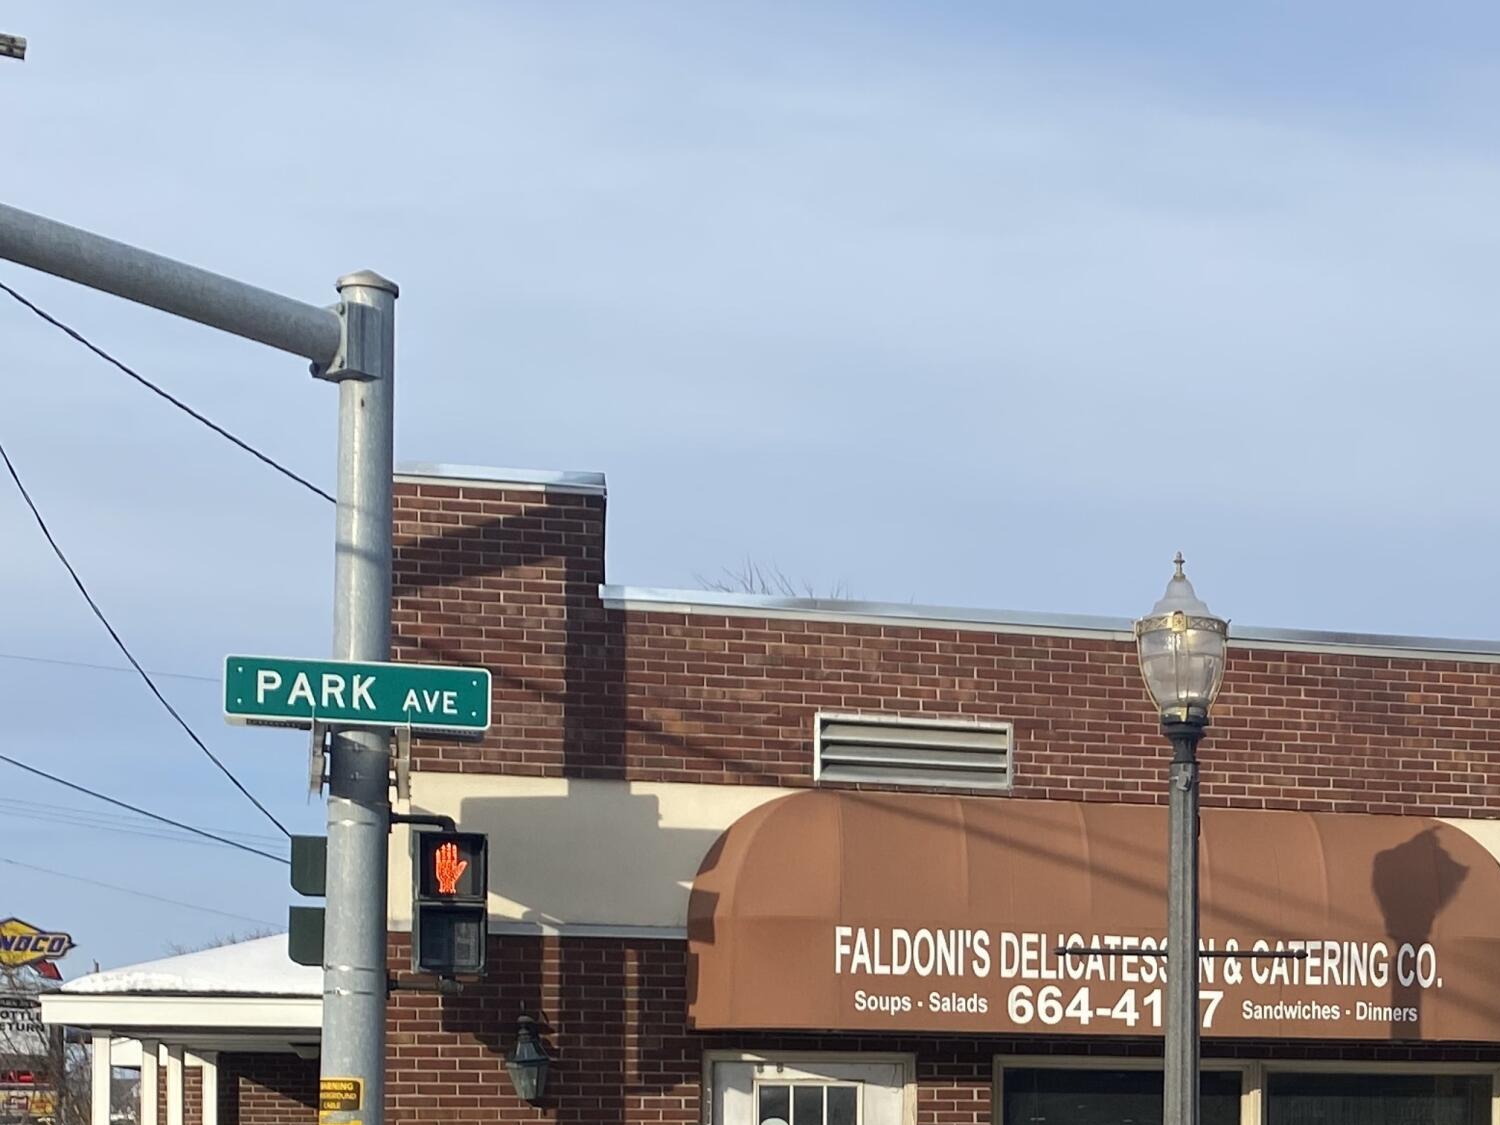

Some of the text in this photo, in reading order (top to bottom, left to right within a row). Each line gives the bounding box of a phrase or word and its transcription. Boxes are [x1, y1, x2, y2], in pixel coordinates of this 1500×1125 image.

[256, 669, 458, 715] PARK AVE
[834, 926, 1443, 989] FALDONI'S DELICATESN & CATERING CO.
[854, 989, 989, 1015] Soups Salads
[1007, 984, 1224, 1028] 664-417
[1242, 999, 1418, 1022] Sandwiches Dinners
